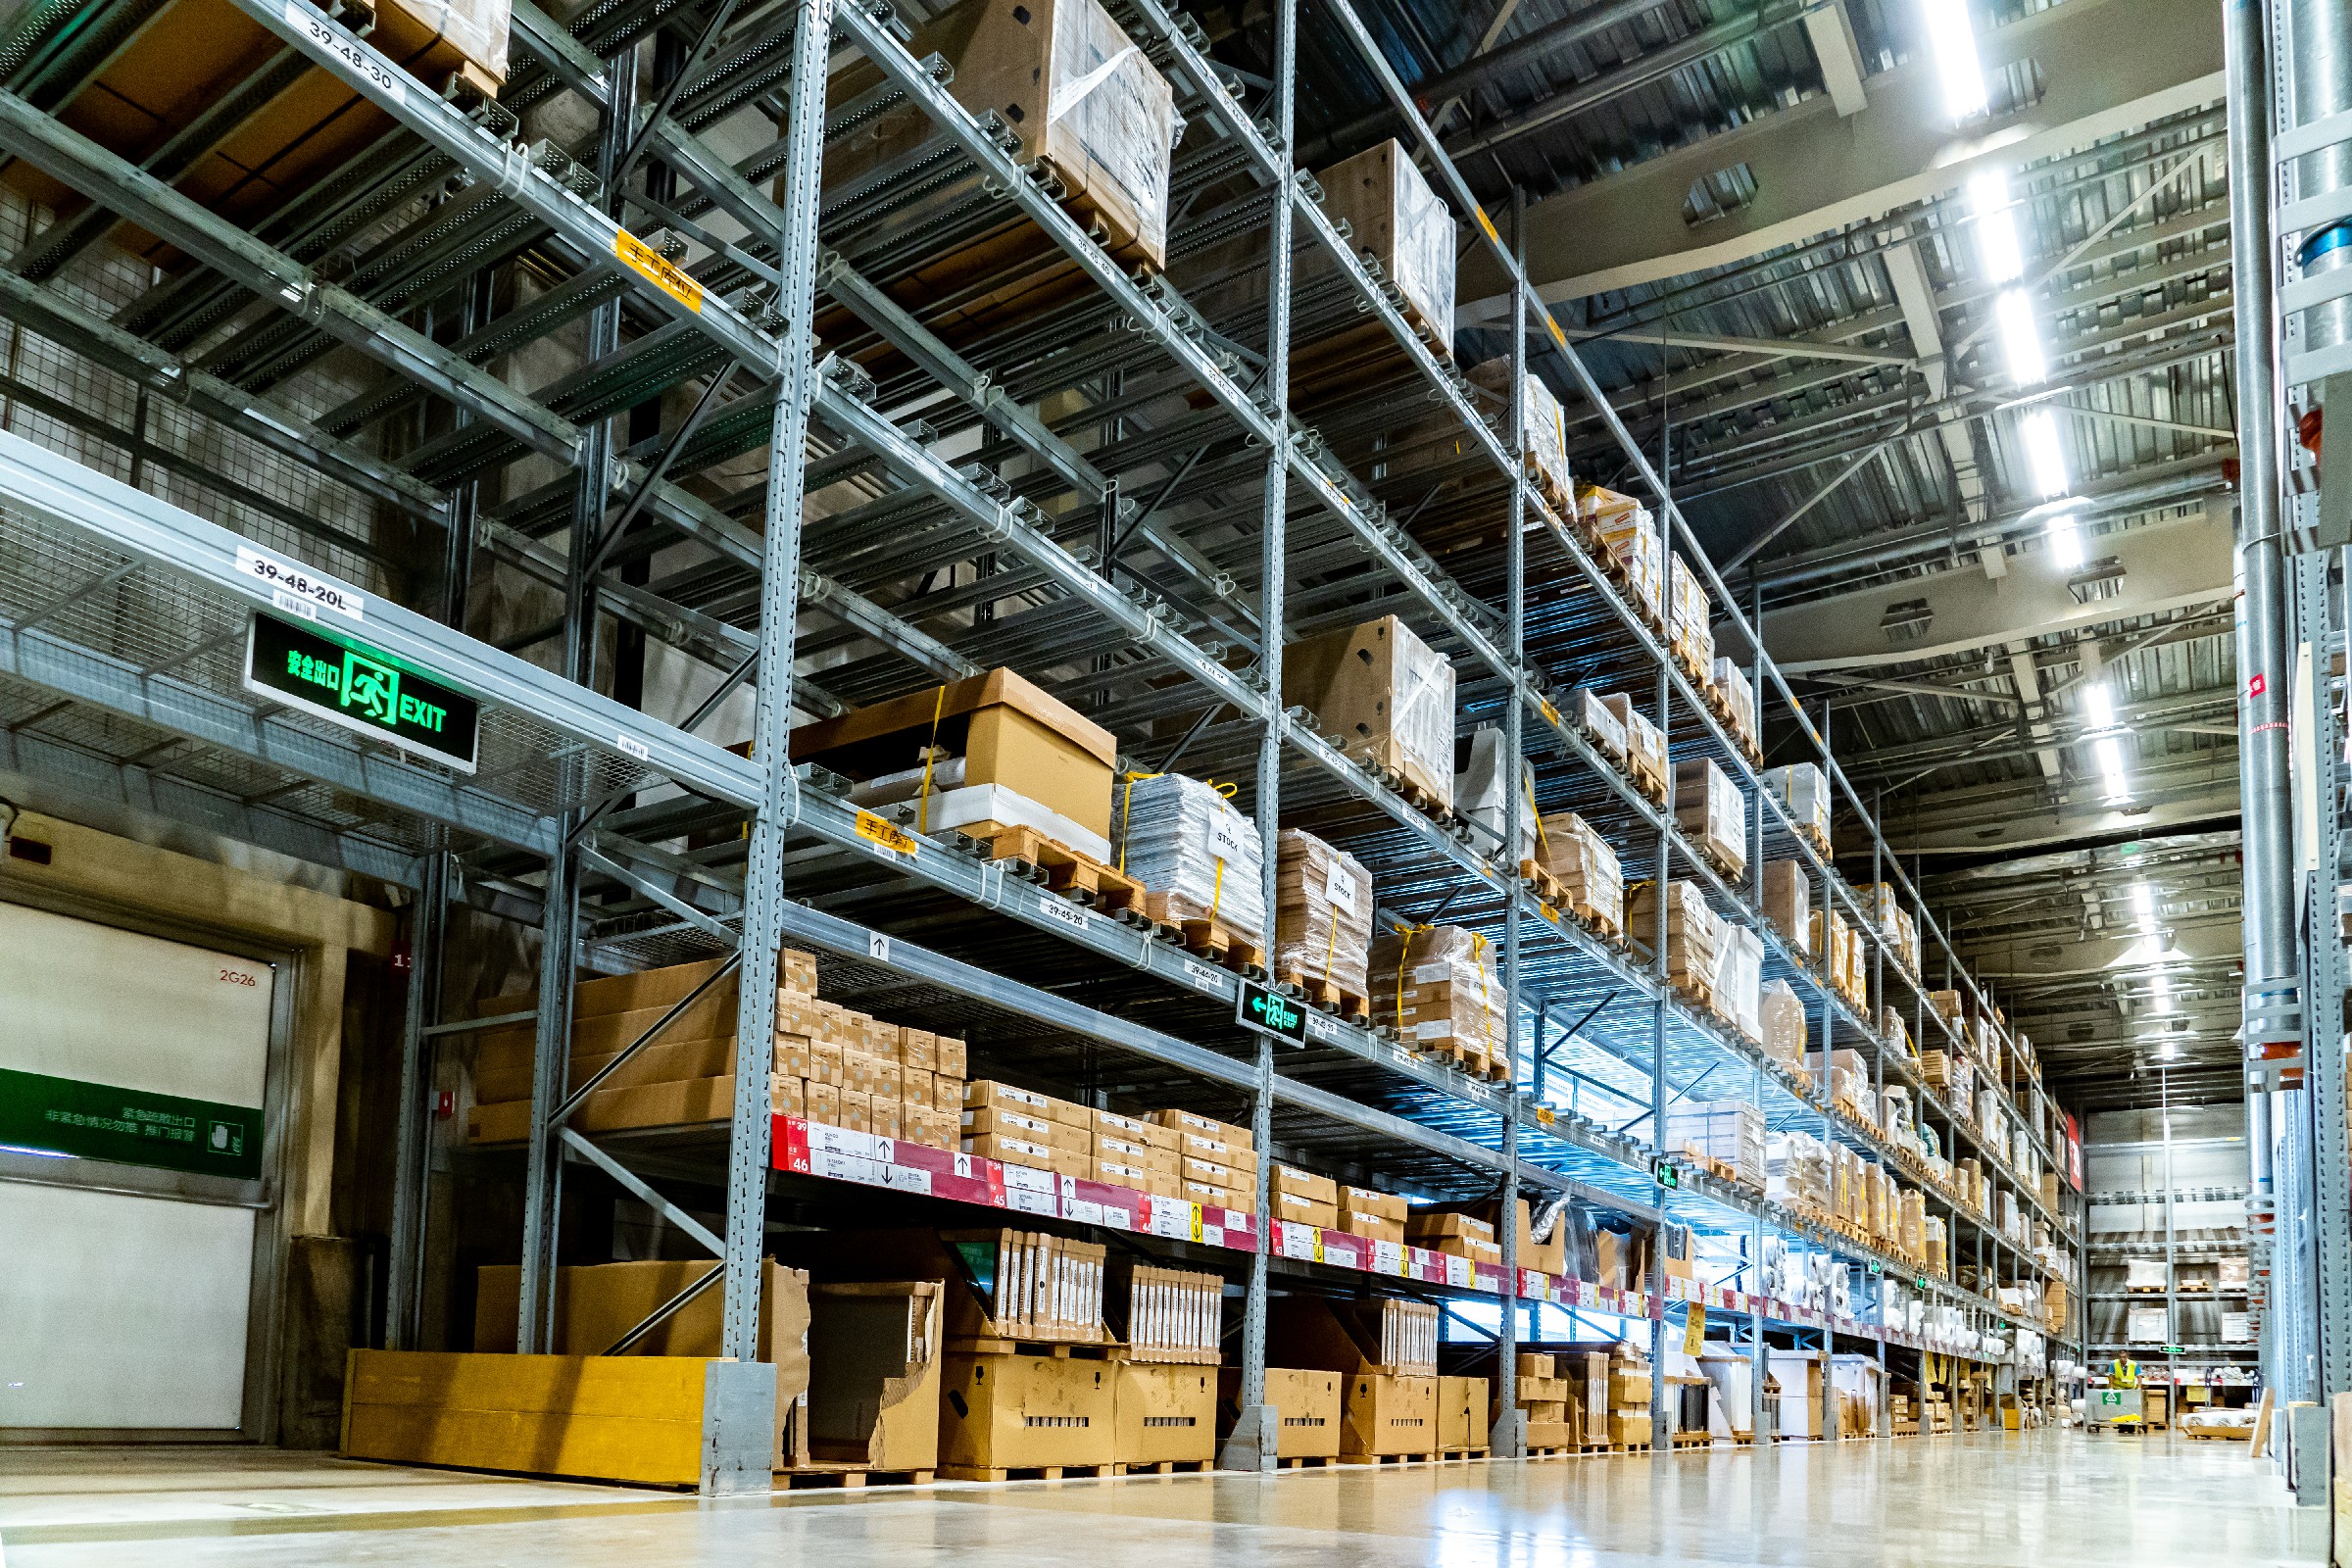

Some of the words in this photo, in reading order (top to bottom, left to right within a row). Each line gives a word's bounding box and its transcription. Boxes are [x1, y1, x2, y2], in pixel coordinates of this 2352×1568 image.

[309, 22, 392, 89] 39-48-30
[254, 560, 347, 611] 39-48-20L
[287, 650, 340, 691] 安全出口
[400, 693, 447, 732] EXIT
[1216, 832, 1239, 853] STOCK
[1334, 882, 1351, 900] STOCK
[1049, 904, 1083, 926] 39-45-20
[220, 969, 256, 987] 2G26
[797, 1121, 808, 1132] 39
[793, 1157, 808, 1172] 46
[993, 1162, 1002, 1171] 39
[993, 1195, 1005, 1206] 45
[1142, 1222, 1152, 1234] 44
